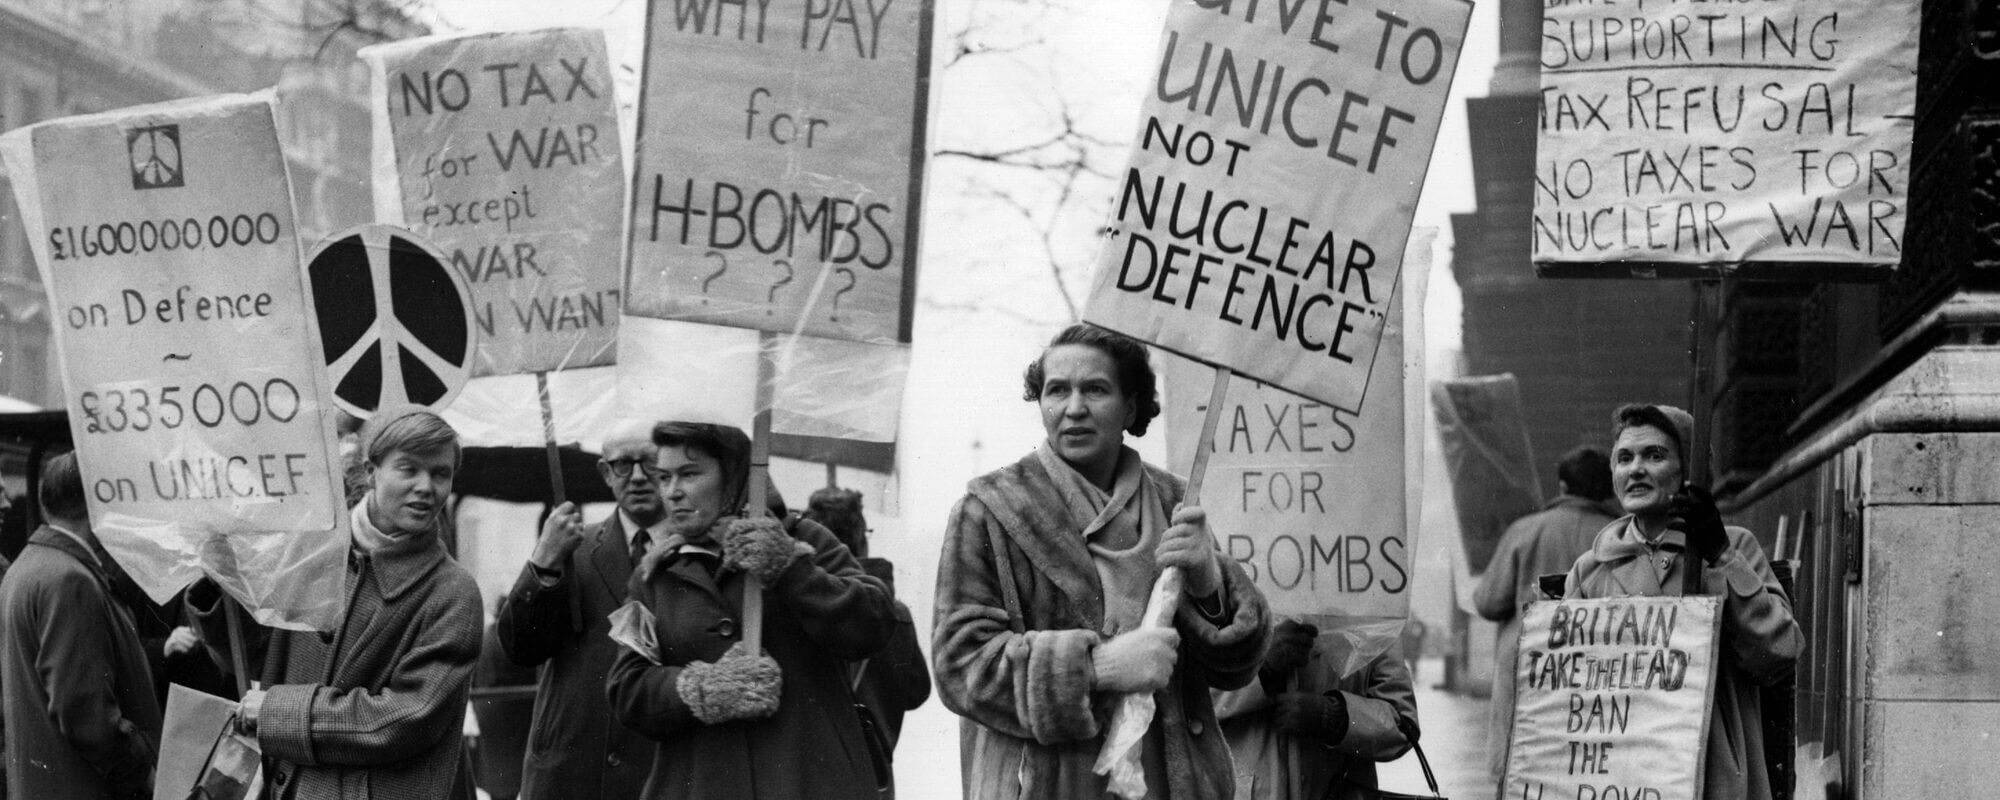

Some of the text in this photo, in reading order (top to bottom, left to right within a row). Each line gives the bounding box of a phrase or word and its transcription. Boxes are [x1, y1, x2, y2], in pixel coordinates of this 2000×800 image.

[801, 0, 894, 59] PAY
[1193, 0, 1444, 85] VE TO
[1541, 12, 1838, 70] SUPPORTING
[401, 57, 600, 117] NO TAX
[1157, 30, 1415, 174] UNICEF
[1540, 85, 1610, 131] TAX
[1627, 76, 1867, 136] REFUSAL
[746, 87, 829, 148] for
[1142, 116, 1251, 177] NOT
[420, 123, 601, 200] for WAR
[1535, 144, 1898, 206] NO TAXES FOR
[422, 185, 538, 233] except
[650, 173, 893, 270] H-BOMBS
[1117, 168, 1378, 304] NUCLEAR
[1534, 197, 1901, 255] NUCLEAR WAR
[67, 286, 272, 330] on Defence
[475, 301, 495, 337] N
[81, 378, 300, 434] £335000
[1197, 403, 1355, 453] AXES
[94, 478, 137, 504] on
[1242, 471, 1325, 514] FOR
[1548, 604, 1677, 649] BRITAIN
[1528, 651, 1585, 690] TAKE
[1585, 655, 1621, 691] THE
[1567, 693, 1630, 734] BAN
[1568, 741, 1613, 775] THE
